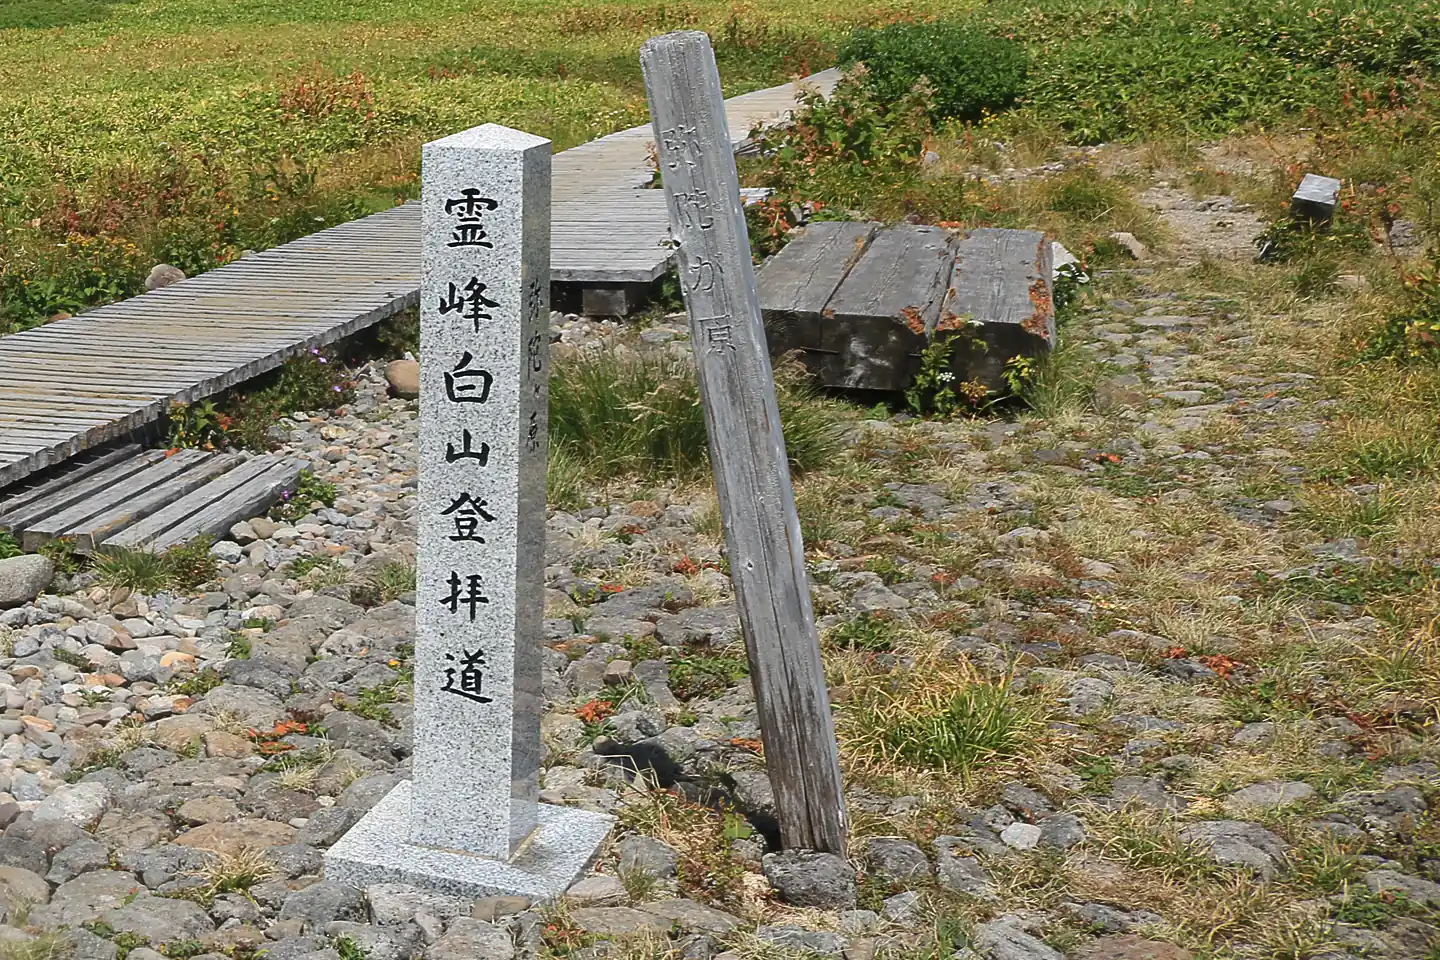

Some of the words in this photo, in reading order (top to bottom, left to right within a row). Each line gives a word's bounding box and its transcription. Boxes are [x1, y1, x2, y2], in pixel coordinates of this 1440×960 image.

[439, 188, 500, 704] 霊峰白山登拝道
